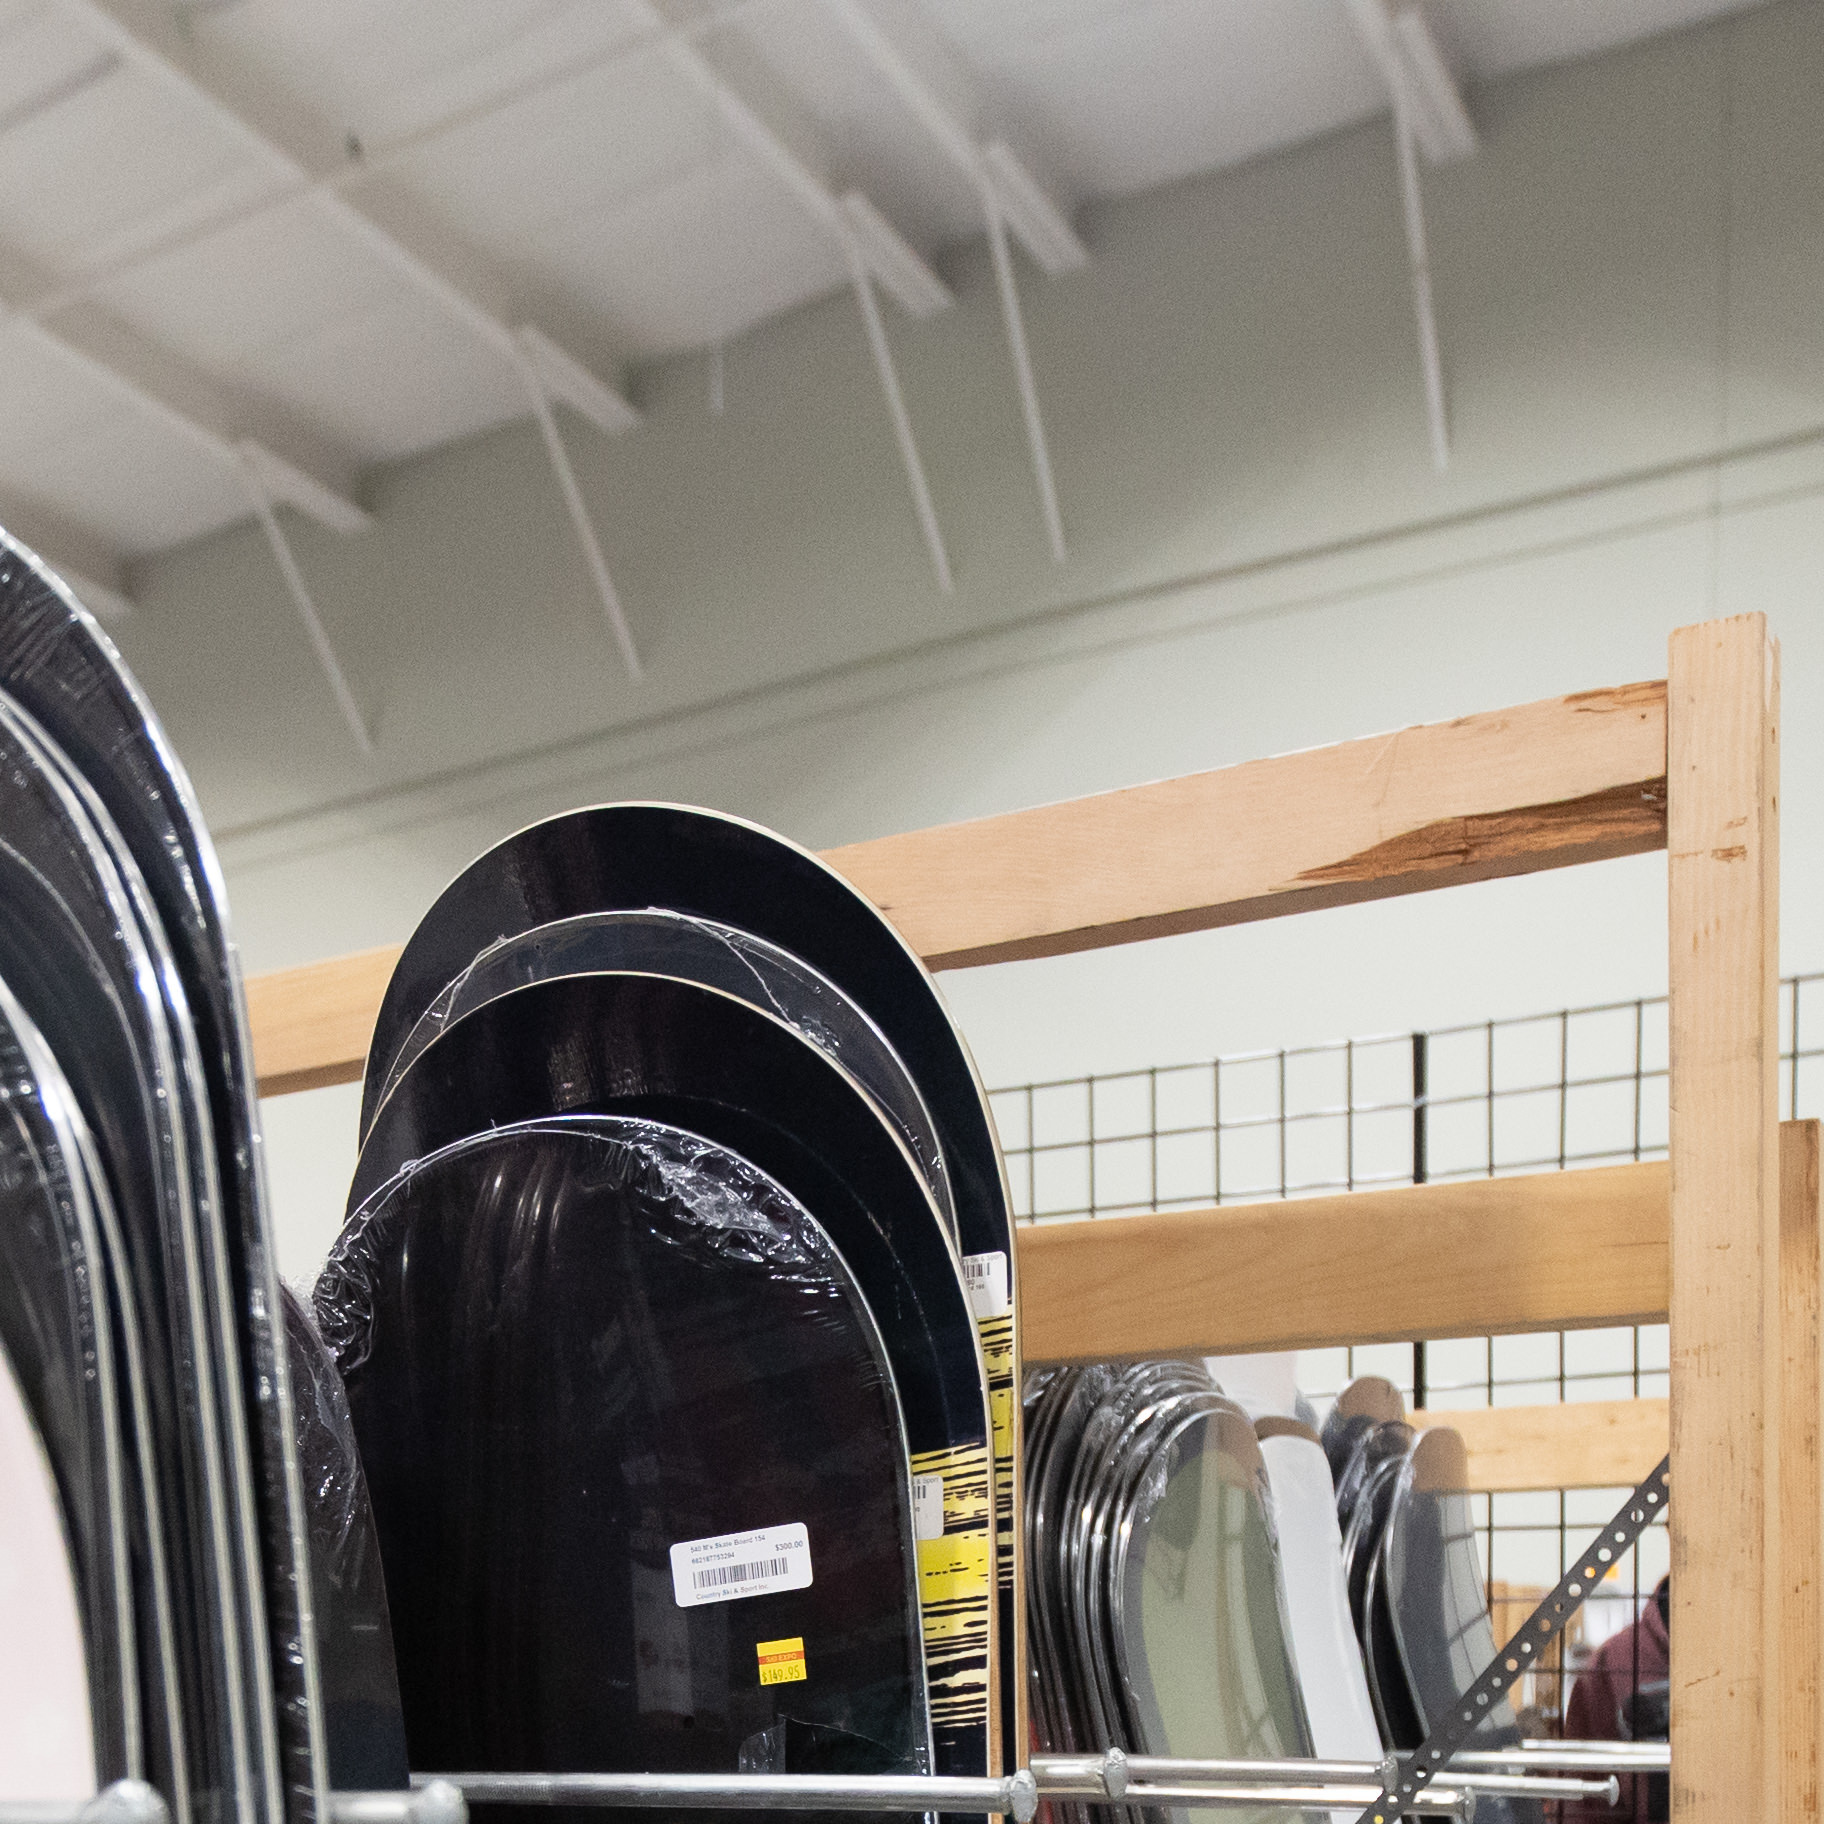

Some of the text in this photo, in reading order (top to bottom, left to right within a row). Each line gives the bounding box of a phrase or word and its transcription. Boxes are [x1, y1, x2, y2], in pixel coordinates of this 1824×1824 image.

[714, 1540, 733, 1549] Skate
[733, 1537, 753, 1546] Board
[775, 1540, 804, 1552] $300.00
[696, 1590, 721, 1601] Country
[722, 1588, 732, 1597] Ski
[740, 1585, 757, 1595] Sport
